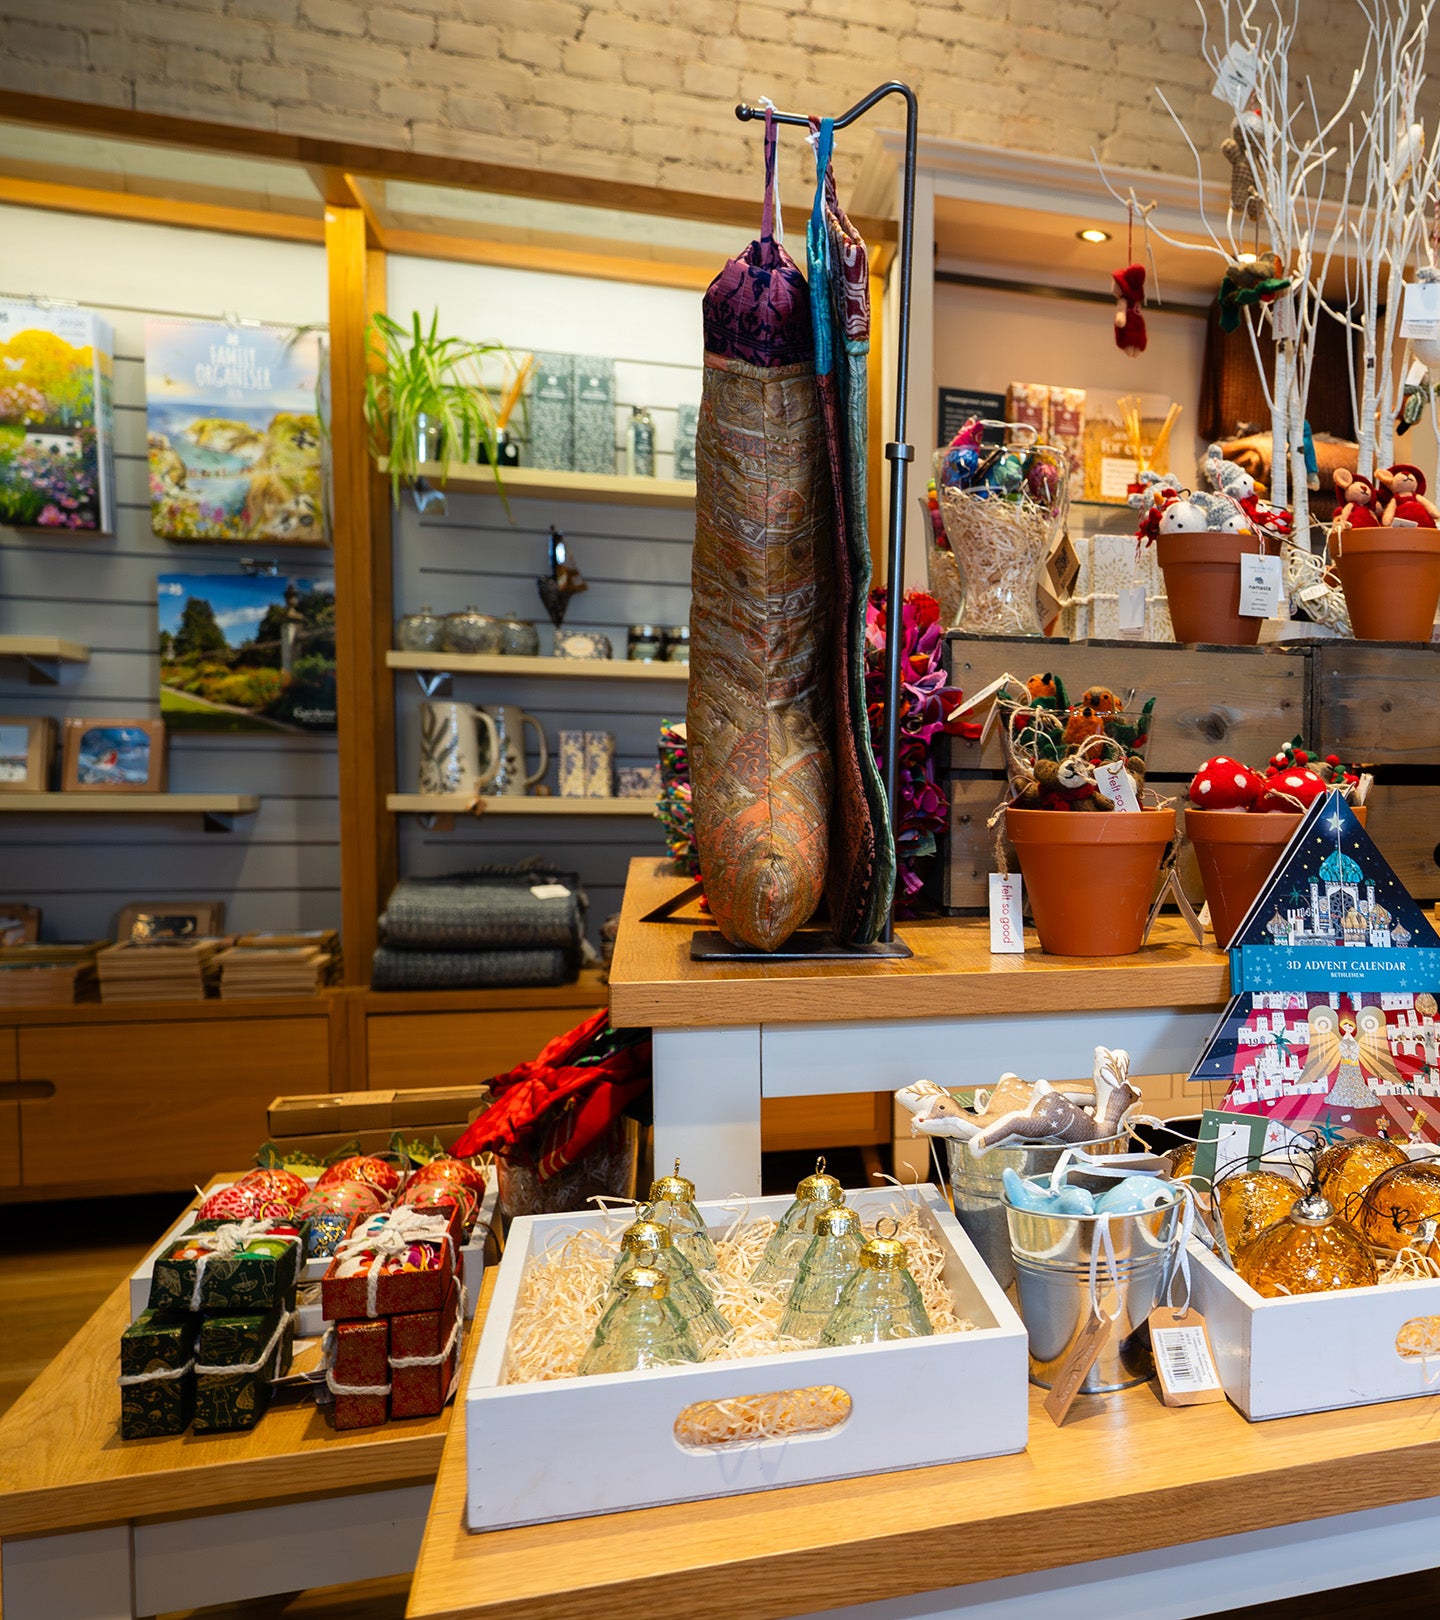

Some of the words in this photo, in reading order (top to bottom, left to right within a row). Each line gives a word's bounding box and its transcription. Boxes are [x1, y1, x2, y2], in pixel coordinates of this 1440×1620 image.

[1108, 775, 1122, 792] felt
[1114, 794, 1125, 807] so
[1001, 884, 1013, 901] felt
[1002, 903, 1010, 915] so
[999, 917, 1014, 944] good
[1286, 960, 1302, 970] 3D
[1304, 960, 1348, 971] ADVENT
[1350, 961, 1407, 972] CALENDAR
